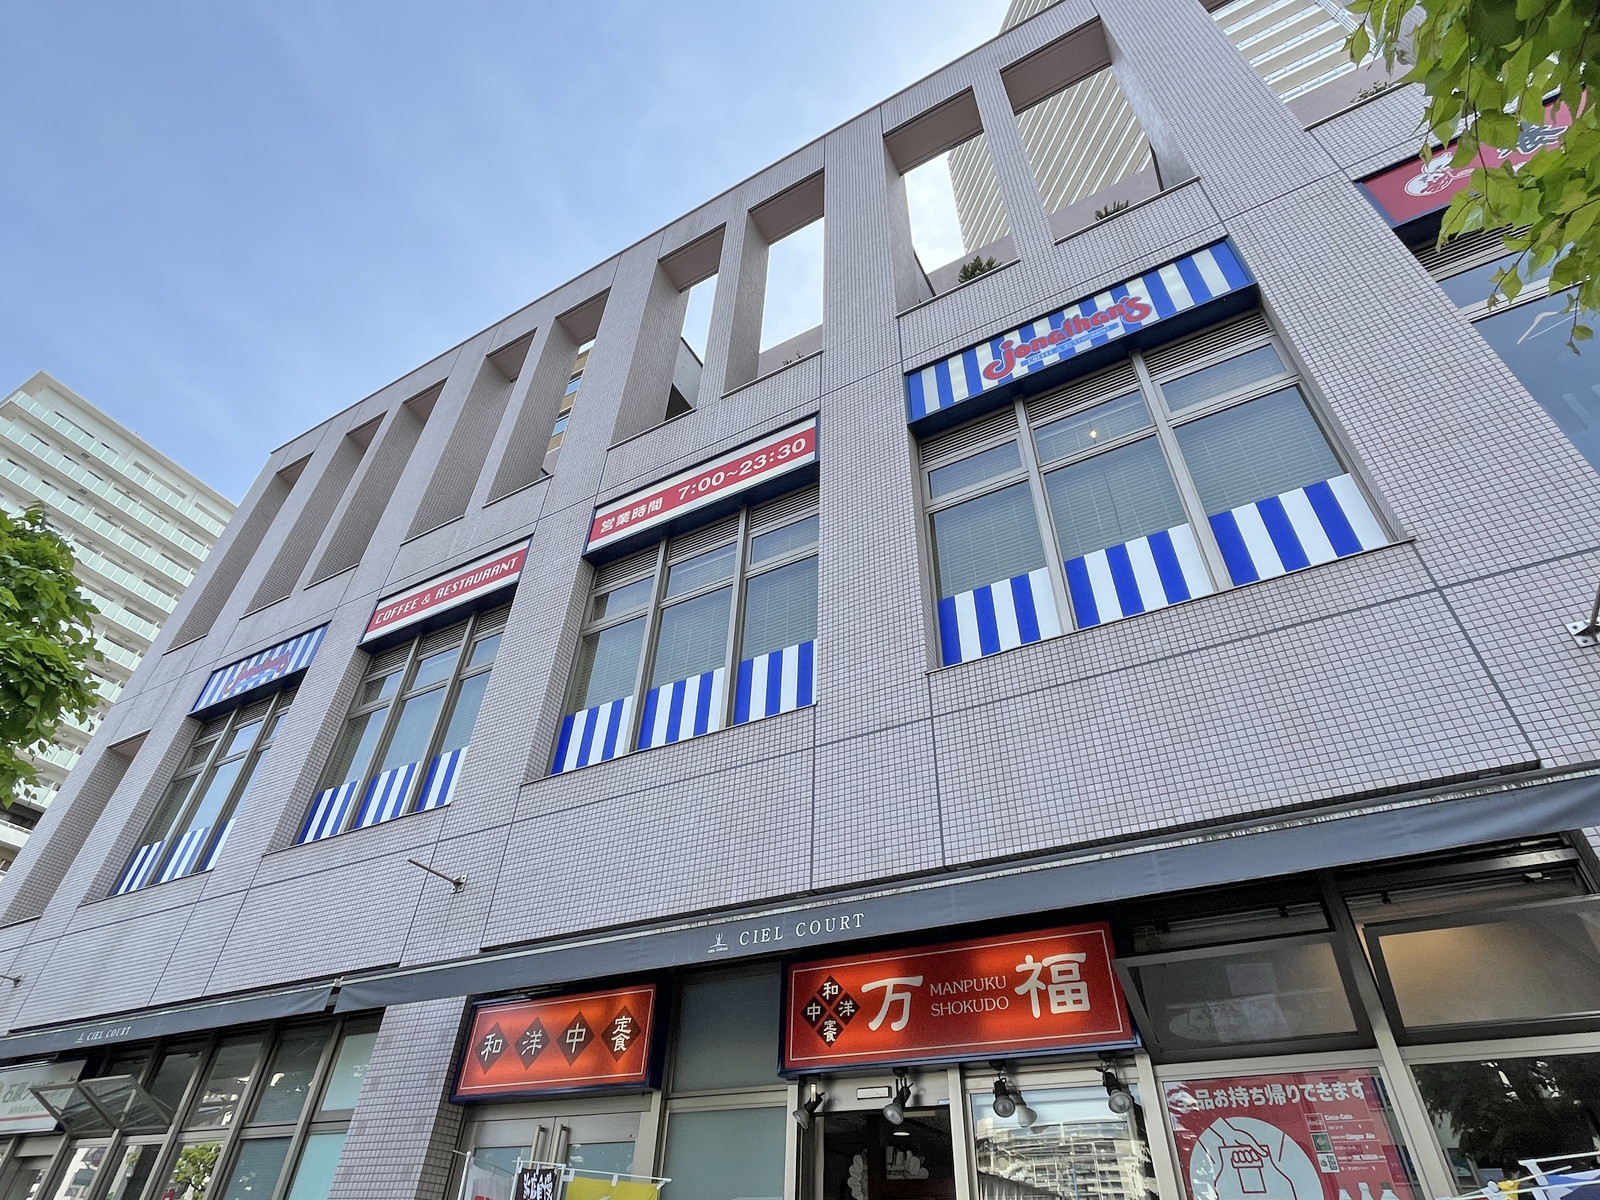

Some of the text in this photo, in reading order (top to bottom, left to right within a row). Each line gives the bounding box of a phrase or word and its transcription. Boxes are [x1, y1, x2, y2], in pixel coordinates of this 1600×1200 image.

[600, 497, 664, 534] 営業時間
[375, 557, 519, 625] COFFEE & RESTAURANT
[739, 913, 865, 946] CIEL COURT
[929, 975, 1008, 997] MANPUKU
[930, 996, 1010, 1017] SHOKUDO
[86, 1026, 132, 1041] CIEL COURT
